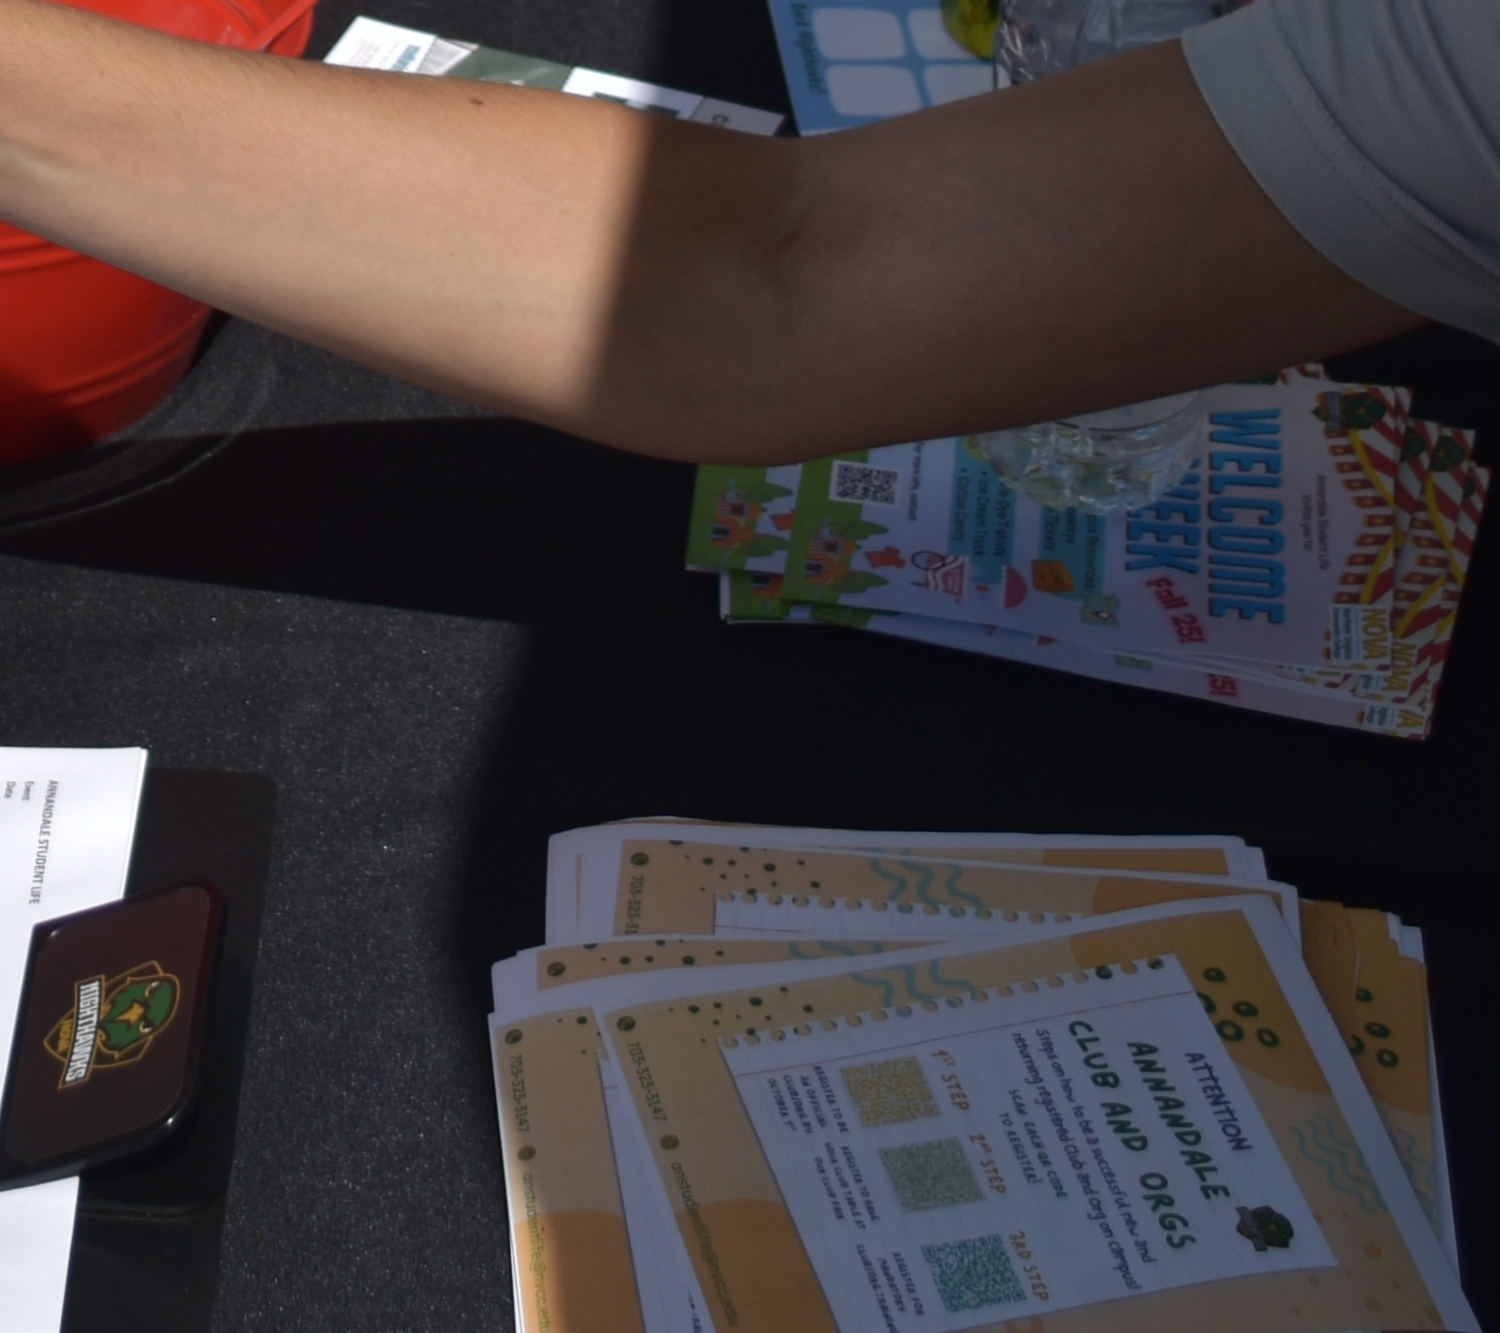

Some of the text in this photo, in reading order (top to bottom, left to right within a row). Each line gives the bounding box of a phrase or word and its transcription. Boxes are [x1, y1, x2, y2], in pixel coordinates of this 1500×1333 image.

[953, 476, 970, 543] Cotton Candy
[973, 478, 990, 557] Ice Cream Truck
[1207, 407, 1287, 625] WELCOME
[1316, 473, 1331, 570] Annandale Student Life
[1083, 535, 1100, 590] Resources
[1146, 576, 1206, 646] Fall 25!
[1361, 606, 1389, 661] NOVA
[3, 780, 17, 800] Date
[21, 780, 36, 802] Event
[28, 778, 60, 906] ANNANDALE STUDENT LIFE
[64, 980, 101, 1084] NIGHTHAWKS
[509, 1053, 531, 1133] 703-323-3147
[627, 1039, 668, 1122] 703-323-3147
[941, 1073, 970, 1113] STEP
[1036, 1028, 1129, 1211] Steps successful
[1185, 1051, 1252, 1153] ATTENTION
[1003, 1129, 1044, 1185] REGISTER!
[1068, 1020, 1197, 1250] CLUB AND ORGS
[1127, 1041, 1231, 1201] ANNANDALE
[979, 1158, 1007, 1195] STEP
[1012, 1032, 1142, 1292] returning registered campus!
[671, 1160, 740, 1327] anstudentlife@nvcc.edu
[1022, 1263, 1051, 1303] STEP
